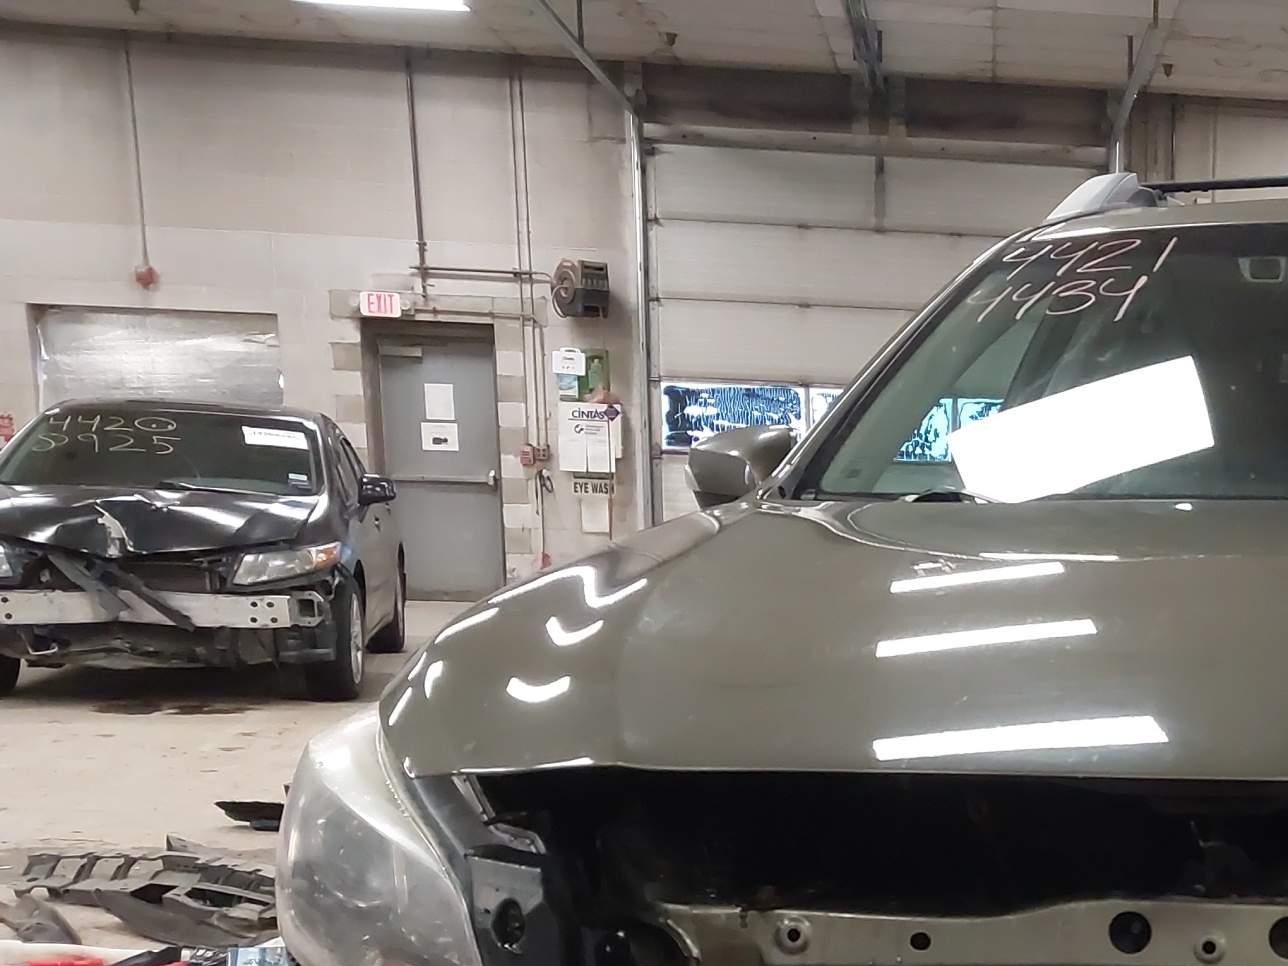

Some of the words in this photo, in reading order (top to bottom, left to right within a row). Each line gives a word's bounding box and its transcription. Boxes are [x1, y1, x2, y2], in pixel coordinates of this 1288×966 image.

[1002, 236, 1178, 281] 4421
[367, 293, 395, 315] EXIT
[967, 275, 1149, 322] 4434
[49, 415, 177, 432] 4420
[573, 482, 589, 494] EYE
